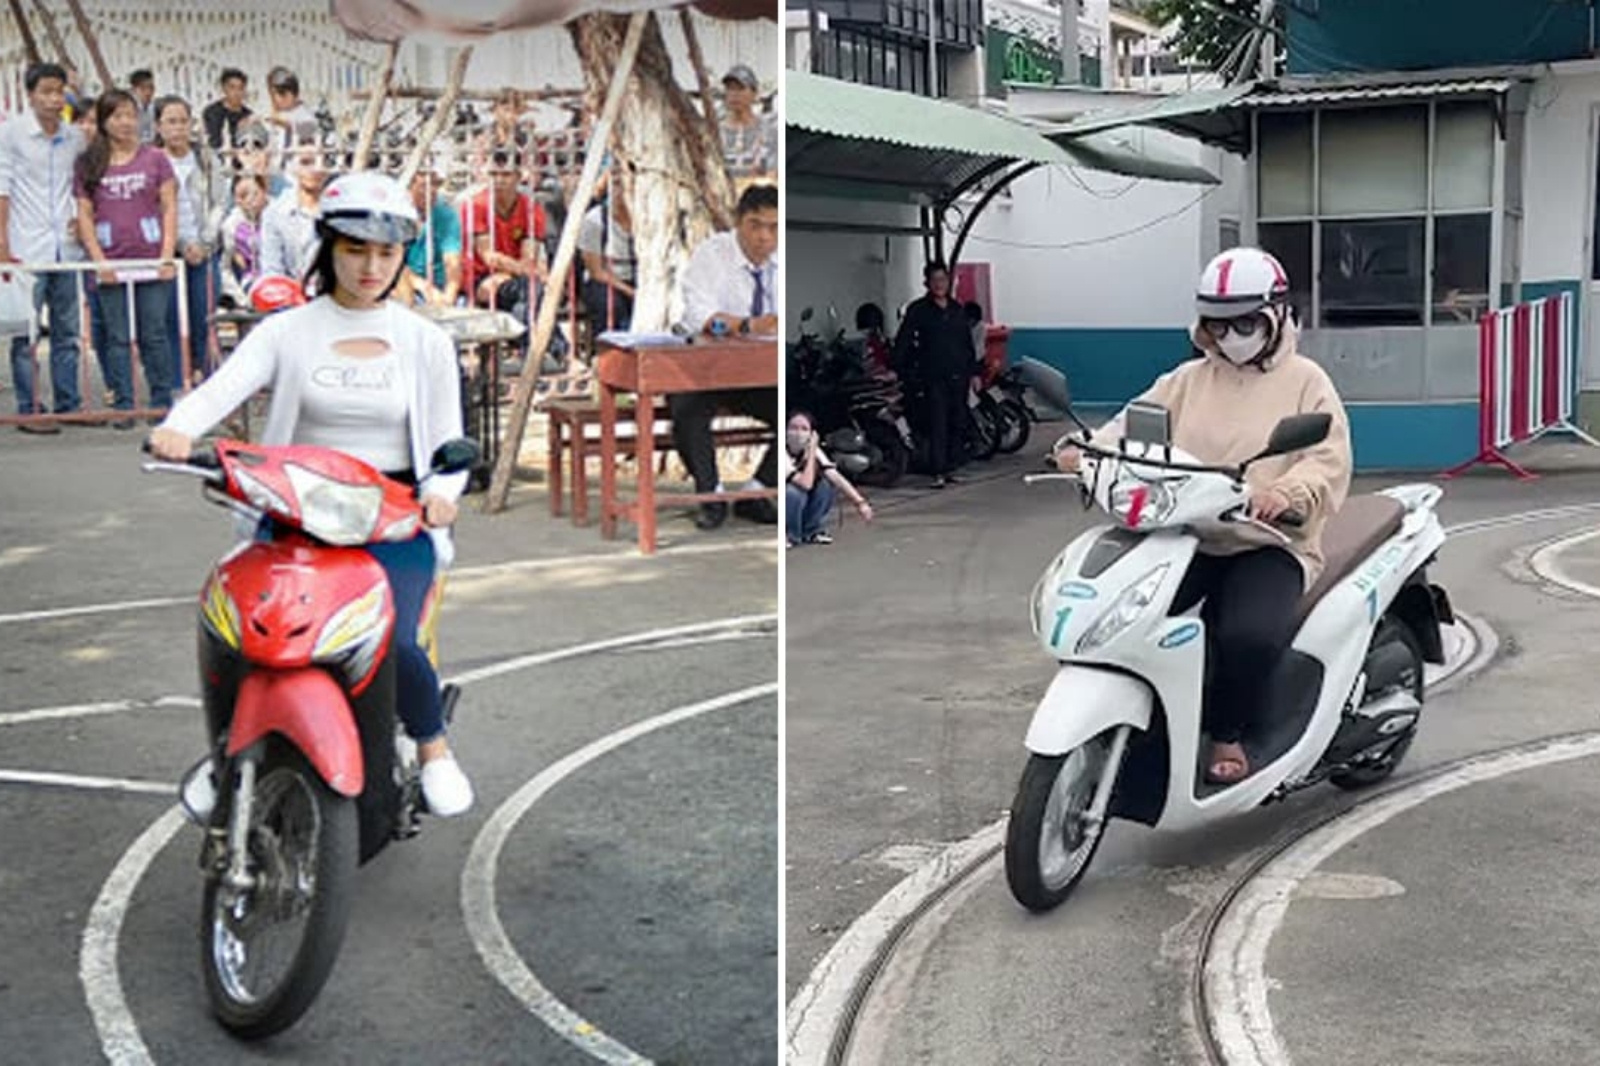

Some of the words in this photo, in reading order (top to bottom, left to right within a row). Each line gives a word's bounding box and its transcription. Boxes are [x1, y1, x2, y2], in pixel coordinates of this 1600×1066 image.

[1216, 259, 1233, 298] 1
[1126, 485, 1149, 530] 1
[1051, 607, 1072, 647] 1
